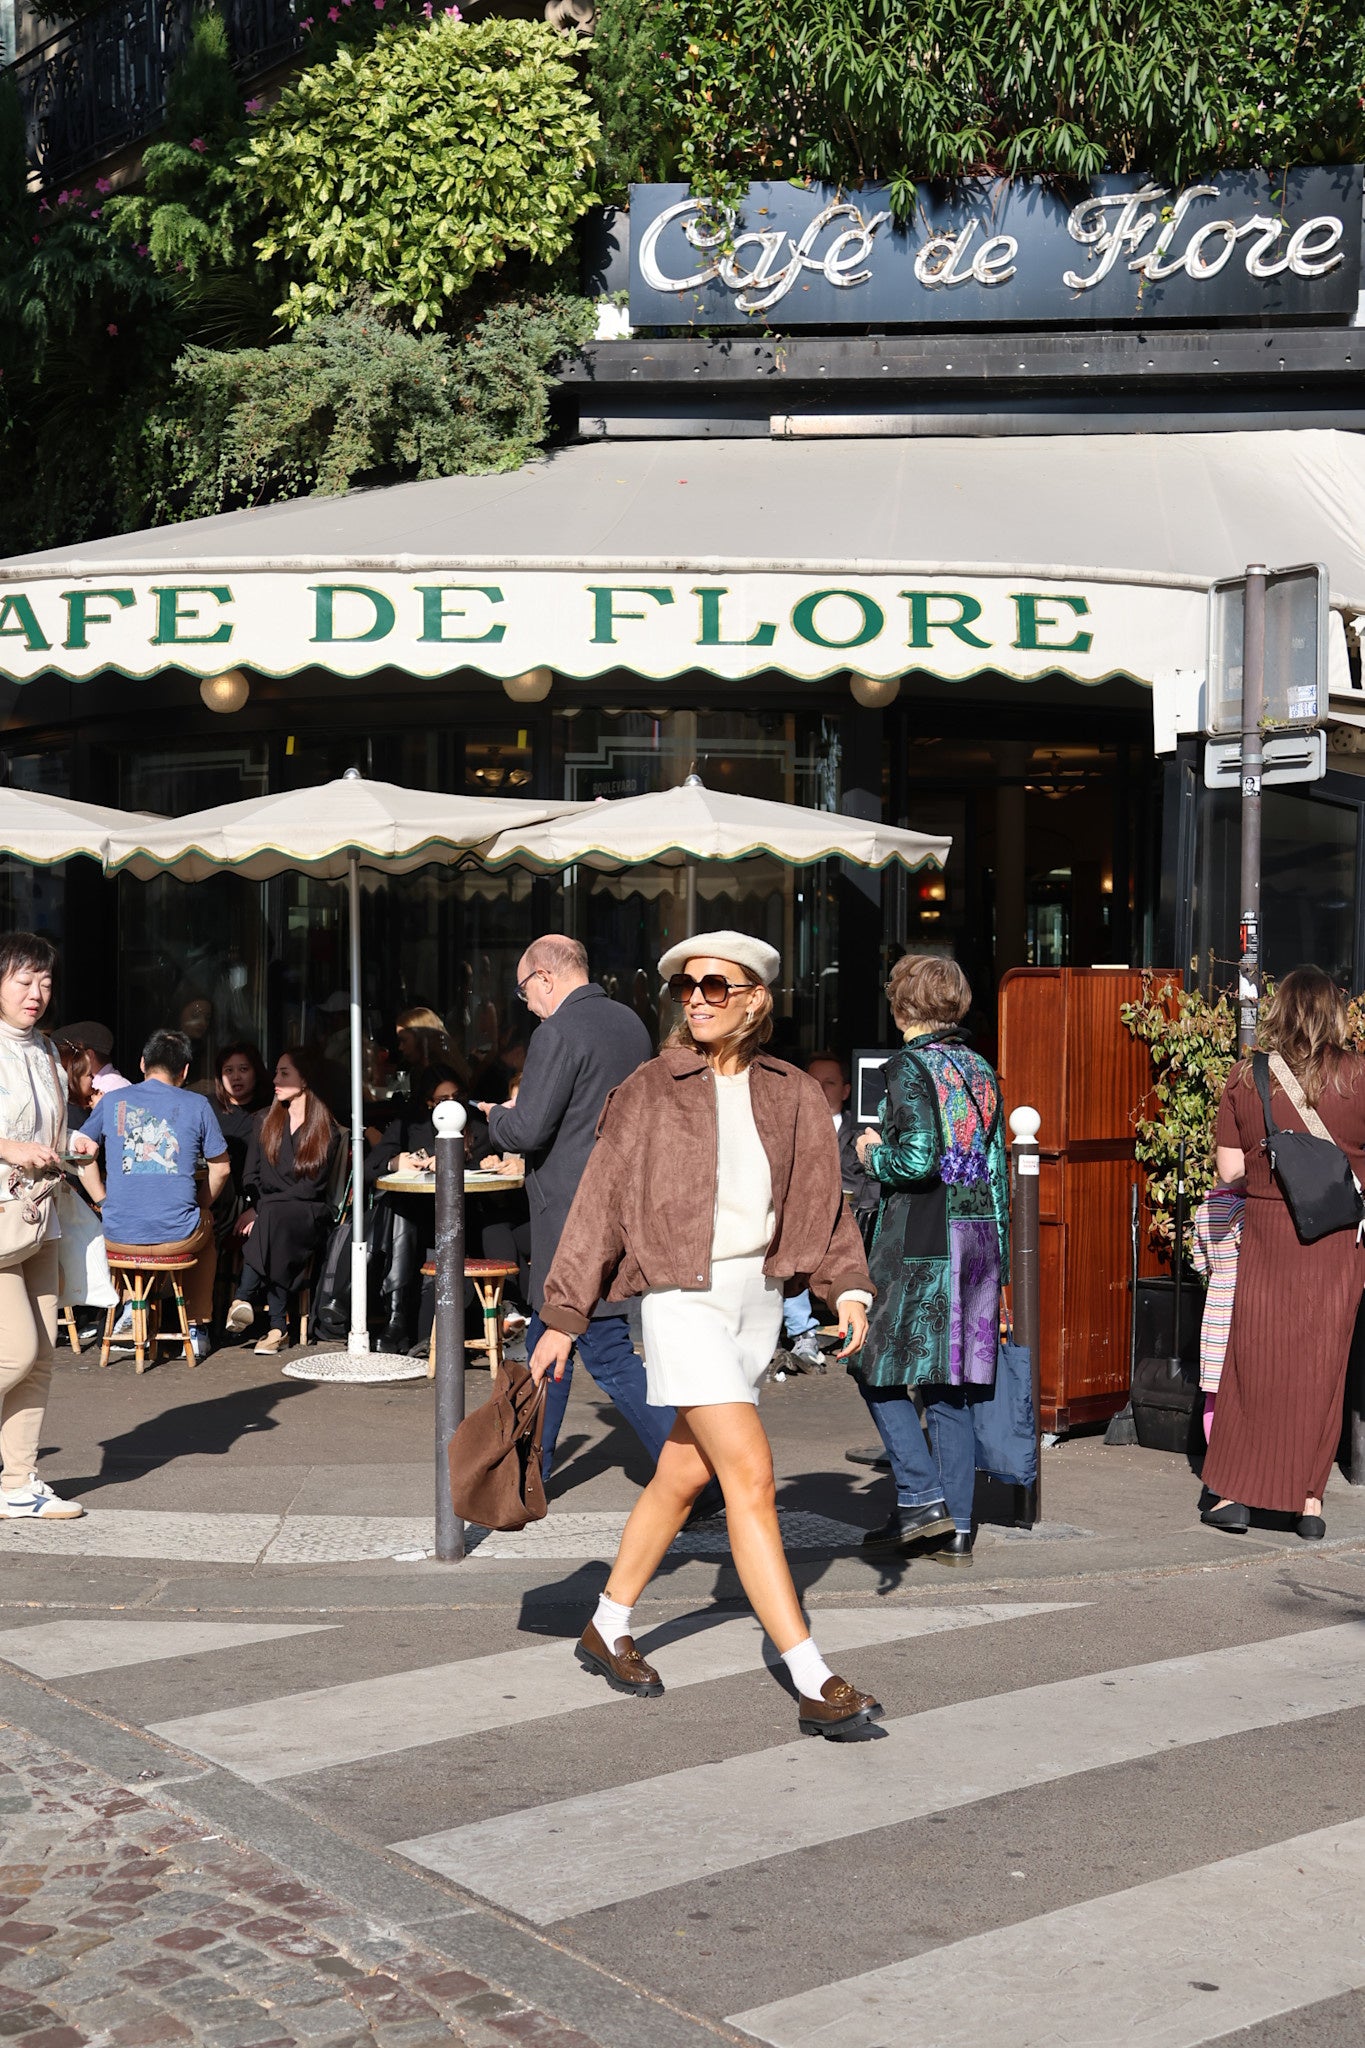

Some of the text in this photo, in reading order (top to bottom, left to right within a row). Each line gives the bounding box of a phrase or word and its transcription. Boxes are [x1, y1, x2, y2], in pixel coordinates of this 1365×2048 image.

[638, 182, 1345, 312] Café de Flore
[306, 583, 508, 644] DE
[583, 585, 1095, 654] FLORE
[592, 779, 637, 795] BOULEVARD
